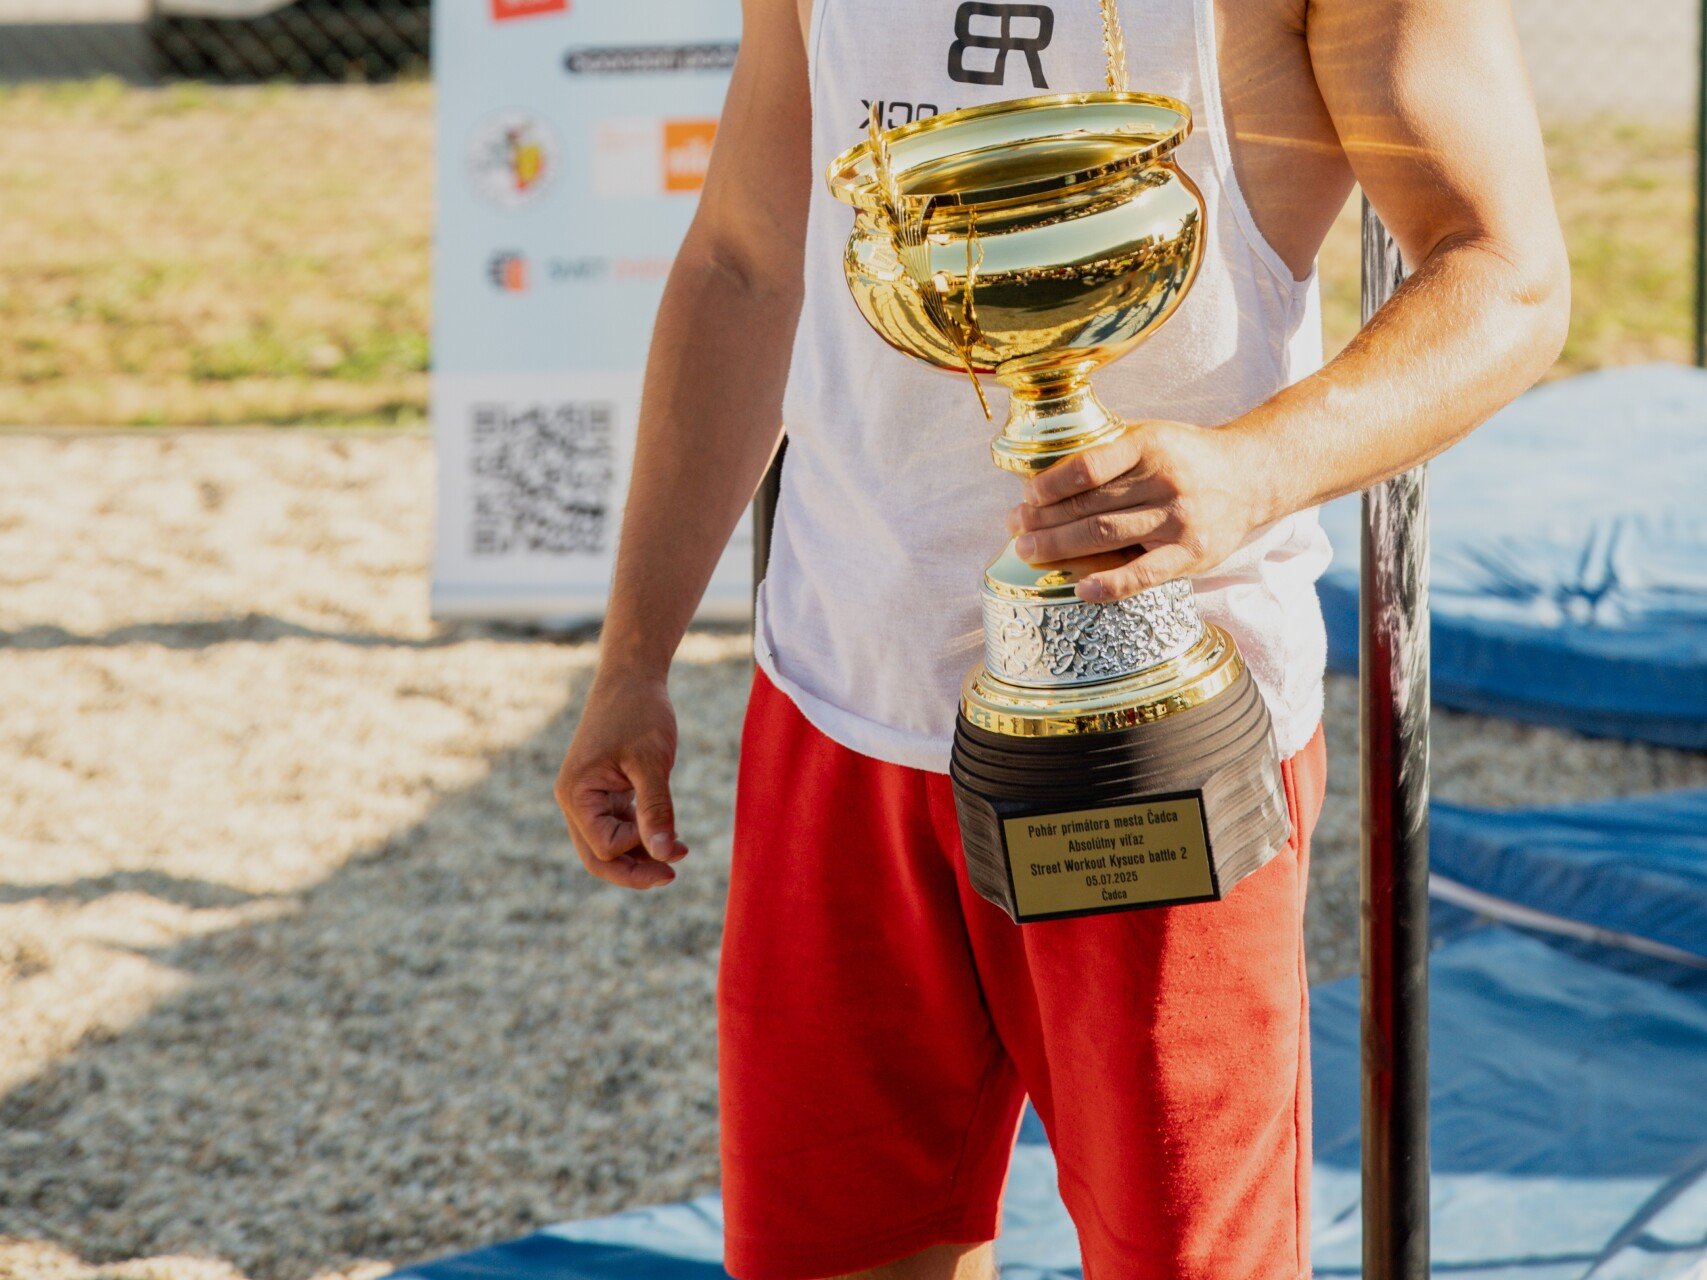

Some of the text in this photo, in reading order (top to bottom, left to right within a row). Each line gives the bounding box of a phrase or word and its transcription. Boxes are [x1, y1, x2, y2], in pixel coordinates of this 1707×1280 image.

[1028, 809, 1178, 838] Pohár primátora mesta Čadca
[1068, 833, 1144, 853] Absolútny víťaz
[1030, 846, 1188, 876] Street Workout Kysuce battle 2
[1086, 871, 1138, 887] 05.07.2025
[1101, 888, 1127, 901] Čadca
